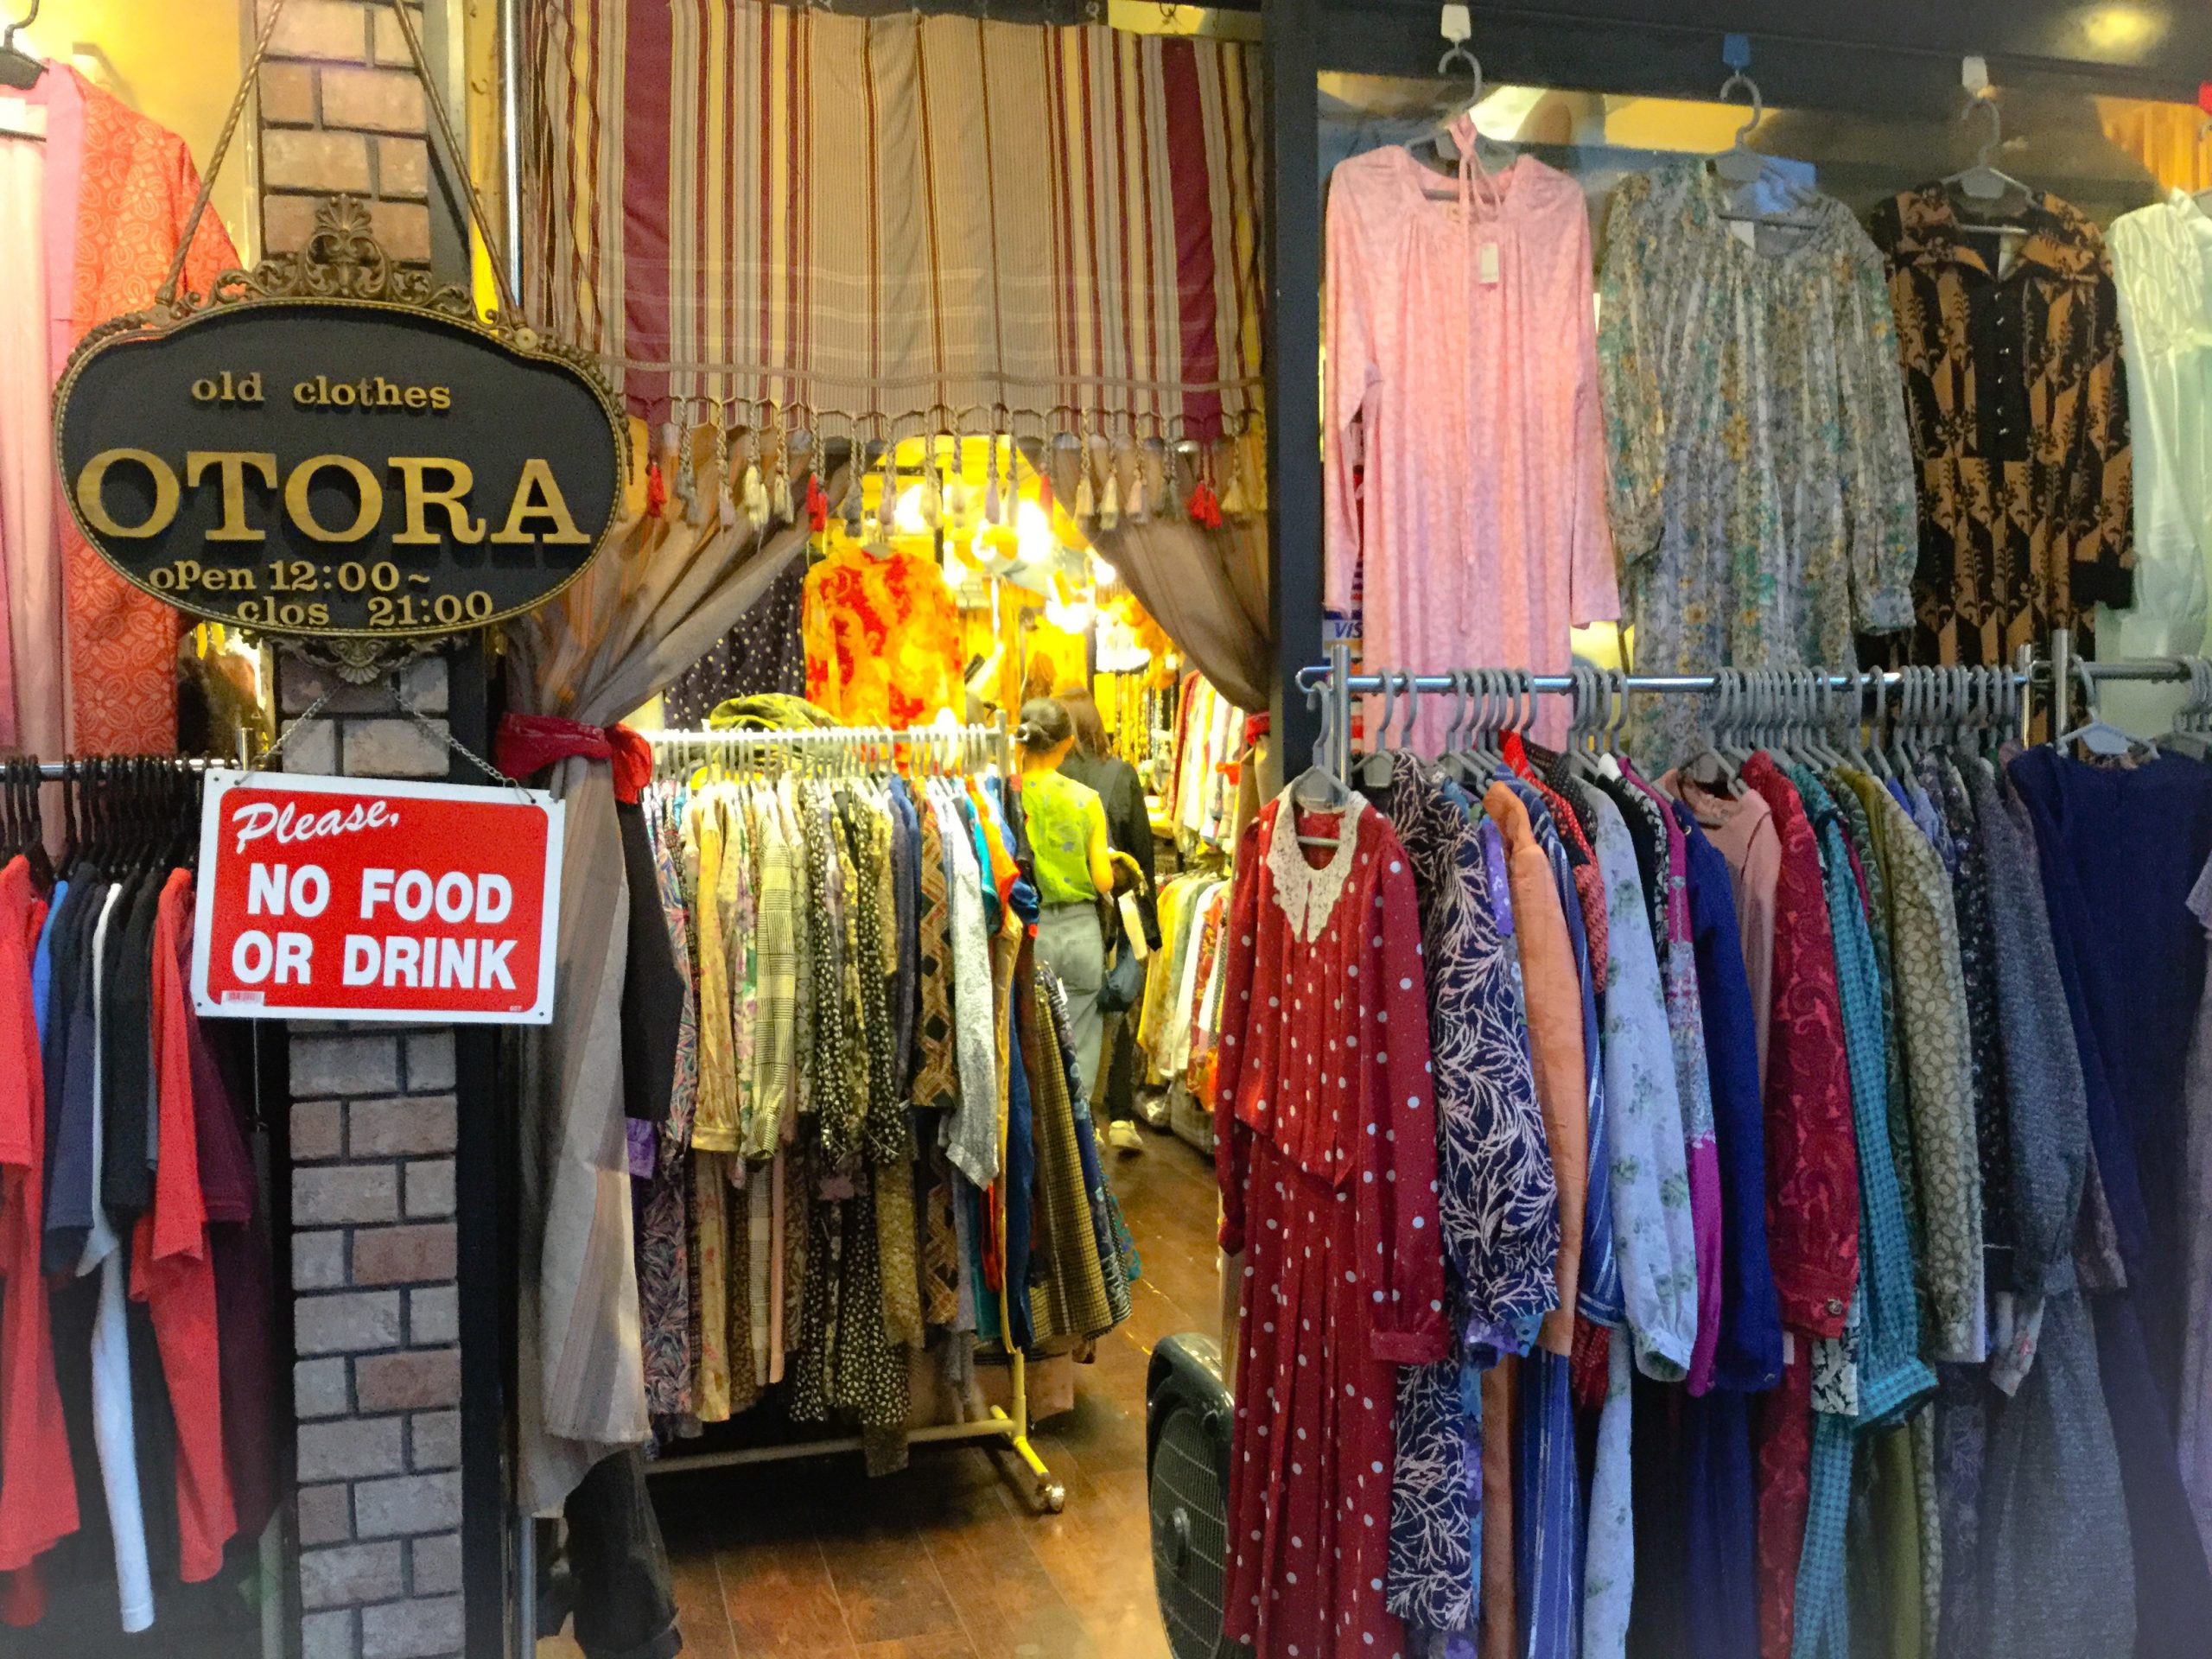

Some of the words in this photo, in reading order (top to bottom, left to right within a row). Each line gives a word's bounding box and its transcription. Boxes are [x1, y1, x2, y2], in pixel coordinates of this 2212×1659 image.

[191, 371, 265, 402] old
[293, 374, 451, 410] clothes
[77, 448, 591, 544] OTORA
[237, 595, 330, 626] clos
[367, 591, 493, 626] 21:00
[1333, 621, 1363, 639] VIS
[232, 800, 399, 855] Please,
[247, 862, 331, 918] NO
[359, 868, 513, 924] FOOD
[232, 930, 314, 985] OR
[342, 934, 518, 990] DRINK
